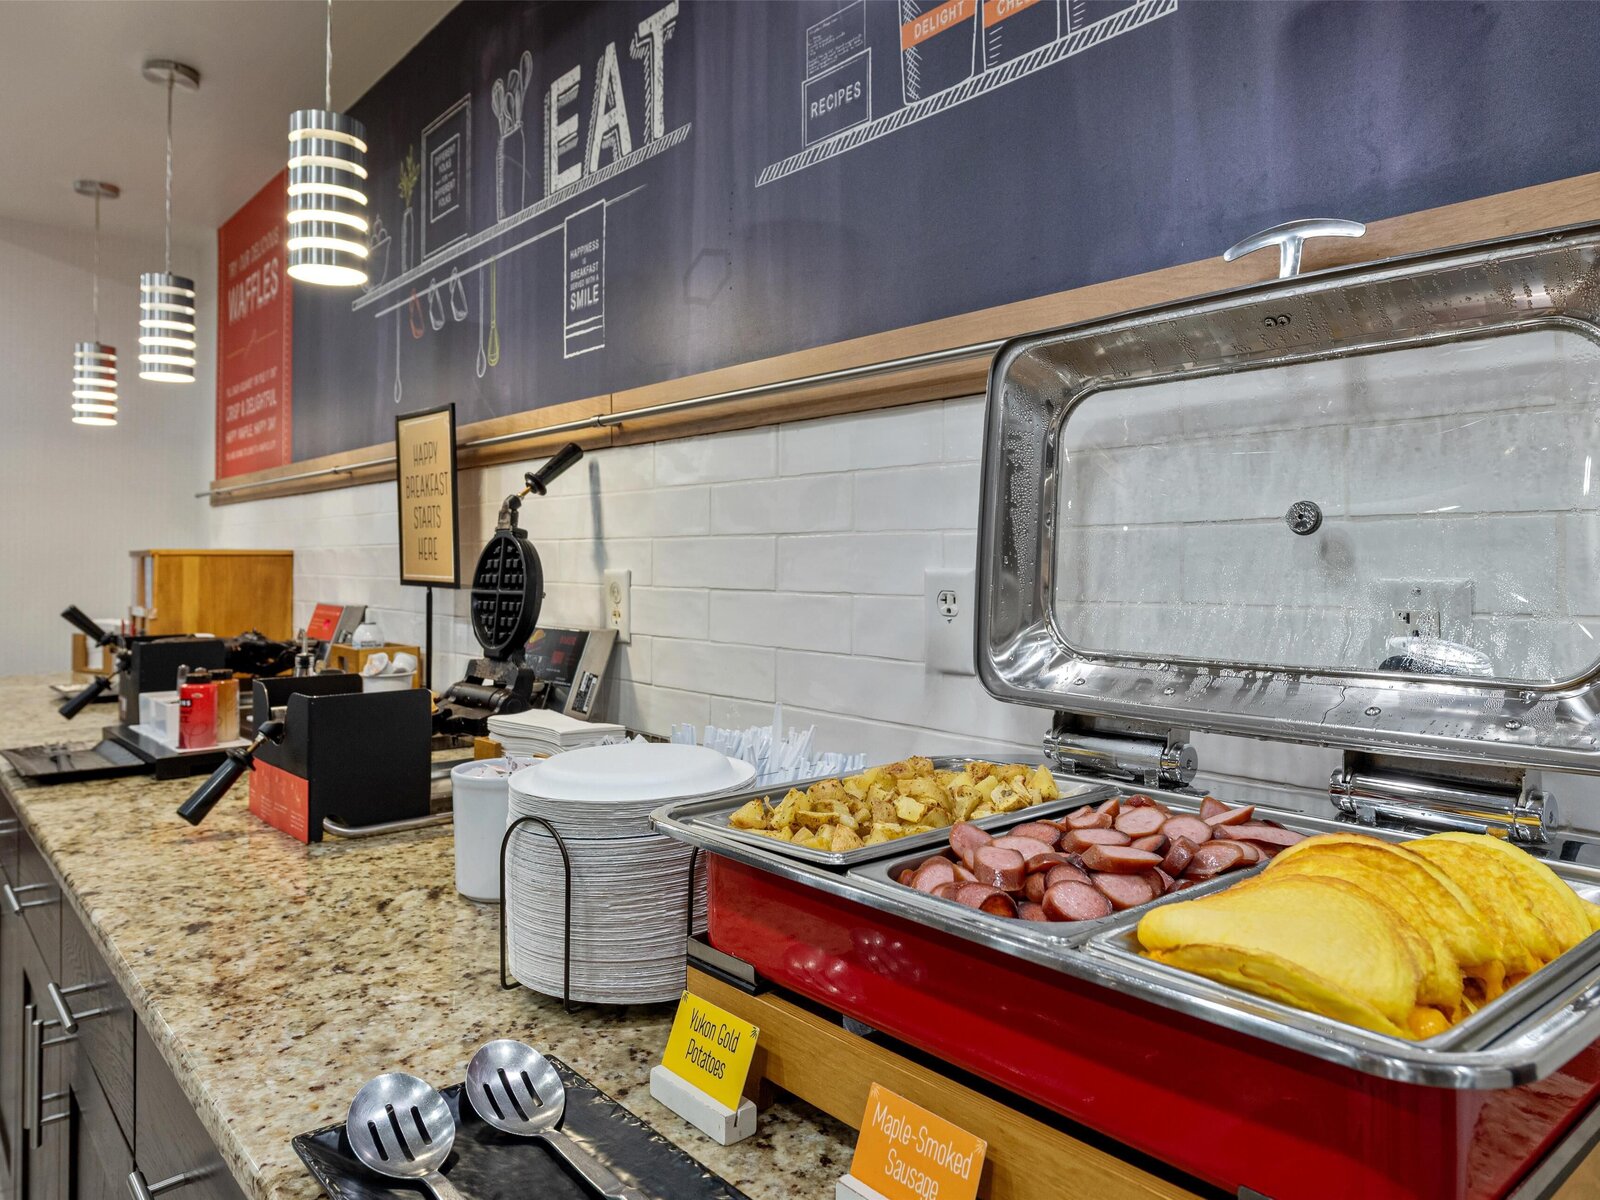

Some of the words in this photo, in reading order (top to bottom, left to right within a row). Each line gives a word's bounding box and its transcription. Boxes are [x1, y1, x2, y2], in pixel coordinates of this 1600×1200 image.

[913, 1, 964, 39] DELIGHT
[546, 0, 679, 198] EAT
[809, 81, 861, 119] RECIPES
[570, 239, 599, 259] HAPPINESS
[570, 261, 599, 281] BREAKFAST
[227, 257, 279, 325] WAFFLES
[570, 284, 599, 312] SMILE
[413, 441, 438, 467] HAPPY
[406, 471, 448, 499] BREAKFAST
[413, 505, 441, 529] STARTS
[418, 537, 438, 561] HERE
[689, 1007, 717, 1041] Yukon
[717, 1023, 741, 1054] Gold
[685, 1038, 726, 1080] Potatoes
[872, 1101, 973, 1180] Maple-Smoked
[884, 1148, 939, 1200] Sausage
